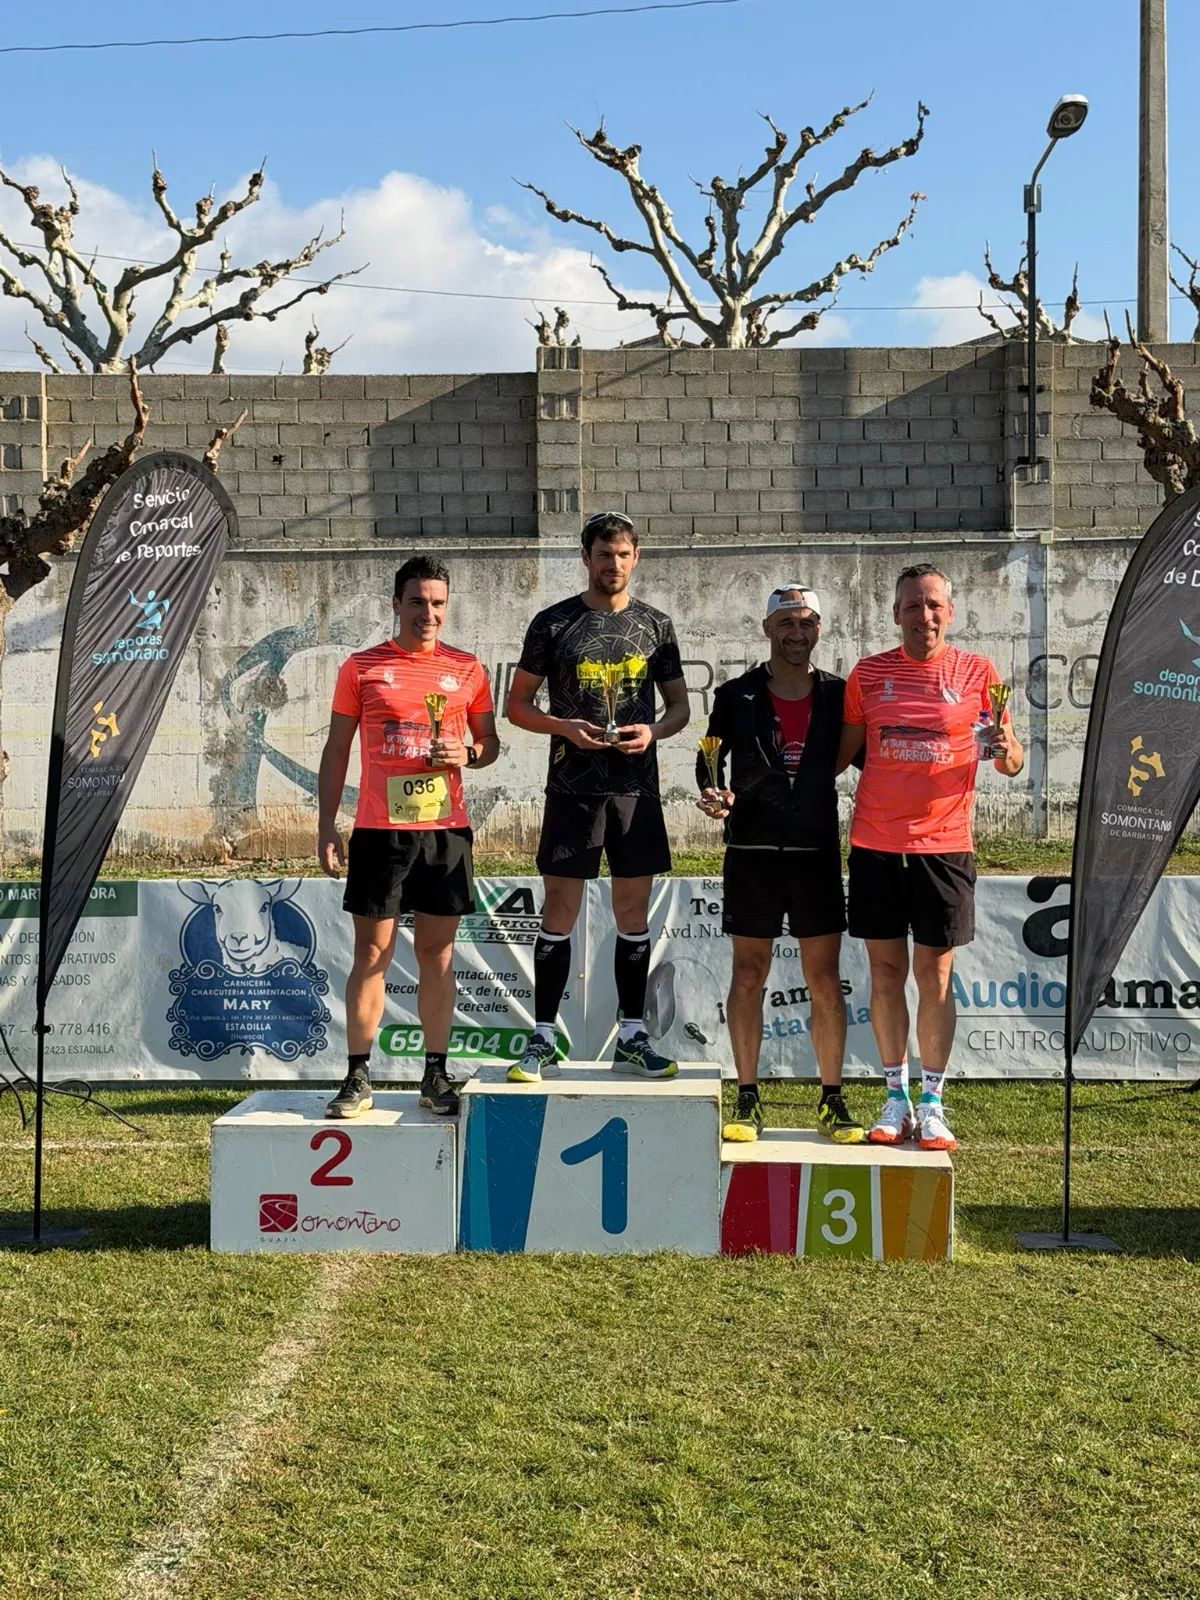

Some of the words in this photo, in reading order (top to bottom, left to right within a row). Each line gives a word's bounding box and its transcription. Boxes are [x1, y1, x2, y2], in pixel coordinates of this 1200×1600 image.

[1163, 567, 1187, 585] de
[1132, 680, 1200, 702] somont
[403, 779, 435, 796] 036
[1117, 804, 1152, 815] COMARCA
[1101, 812, 1172, 832] SOMONTANO
[1110, 829, 1119, 837] DE
[481, 918, 540, 928] AGRICO
[8, 933, 15, 943] Y
[456, 931, 536, 941] VACIONES
[21, 976, 28, 986] Y
[476, 986, 492, 998] de
[494, 986, 531, 999] frutos
[457, 1002, 509, 1013] cereales
[60, 1024, 82, 1035] 778
[87, 1023, 110, 1035] 416
[225, 1023, 272, 1031] ESTADILLA
[390, 1029, 424, 1052] 69
[450, 1032, 500, 1054] 504
[967, 1030, 1066, 1051] CENTRO
[1079, 1031, 1191, 1053] AUDITIVO
[68, 1045, 115, 1054] ESTADILLA
[310, 1129, 354, 1186] 2
[560, 1117, 628, 1235] 1
[821, 1189, 858, 1245] 3
